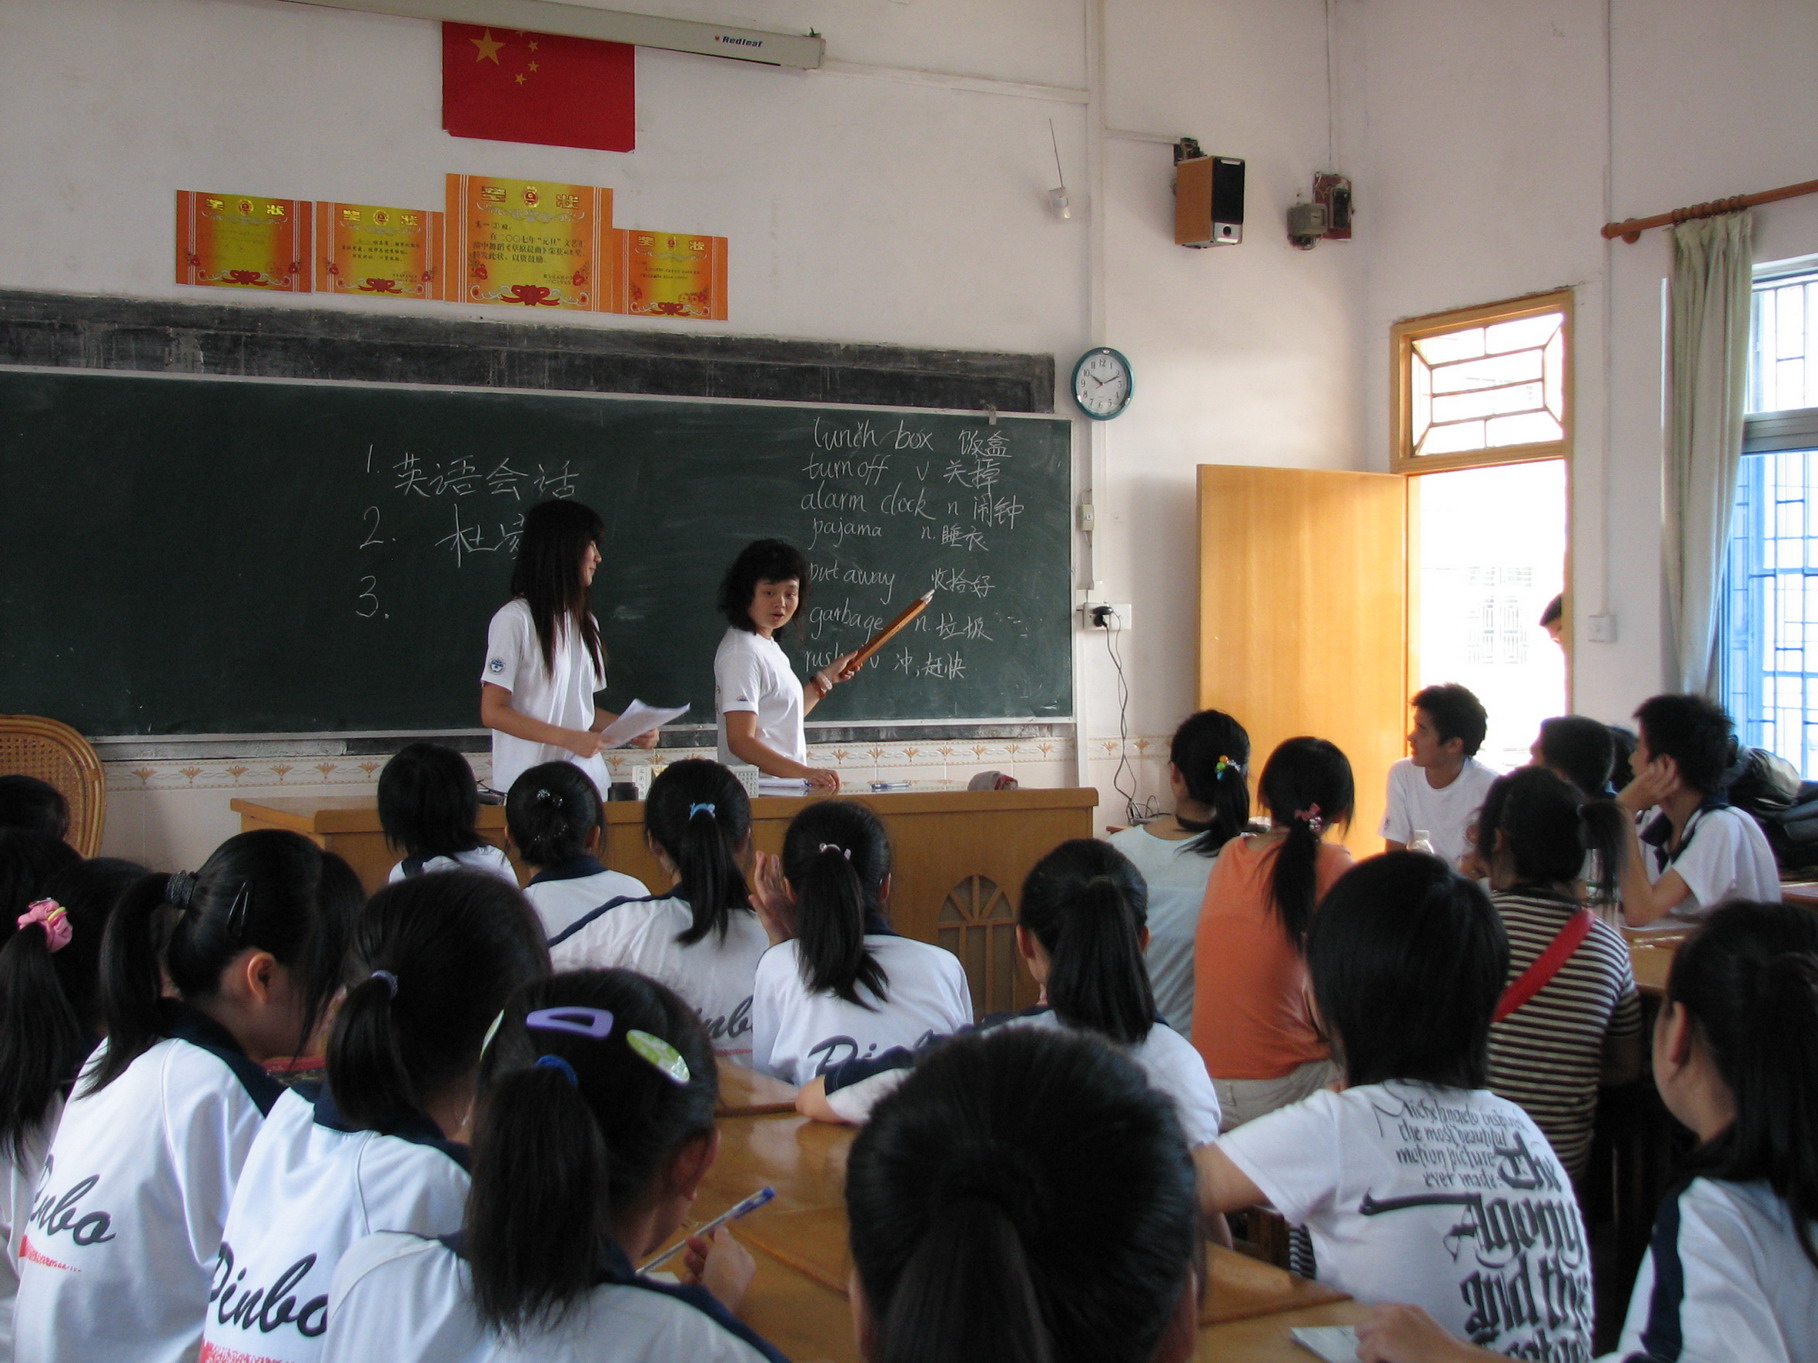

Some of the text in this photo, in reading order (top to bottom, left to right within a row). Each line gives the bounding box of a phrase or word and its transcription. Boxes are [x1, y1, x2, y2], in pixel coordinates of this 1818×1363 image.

[1083, 369, 1090, 377] 10
[1099, 358, 1106, 367] 12
[814, 416, 1012, 458] lunch box 饭盒
[393, 452, 580, 500] 英语会话
[801, 452, 854, 480] turn
[857, 454, 891, 486] off
[800, 480, 867, 512] alarm
[880, 481, 937, 521] clock
[973, 492, 1025, 530] 闹钟
[359, 505, 397, 550] 2.
[808, 517, 882, 551] pajama
[941, 523, 989, 551] 睡衣
[355, 575, 390, 619] 3.
[843, 567, 895, 605] away
[809, 597, 883, 646] garbage
[935, 612, 993, 642] 垃圾
[1424, 1123, 1459, 1147] most
[1395, 1143, 1496, 1171] motion picture
[1422, 1170, 1454, 1188] ever
[1358, 1187, 1584, 1269] Agony
[1459, 1249, 1540, 1336] and
